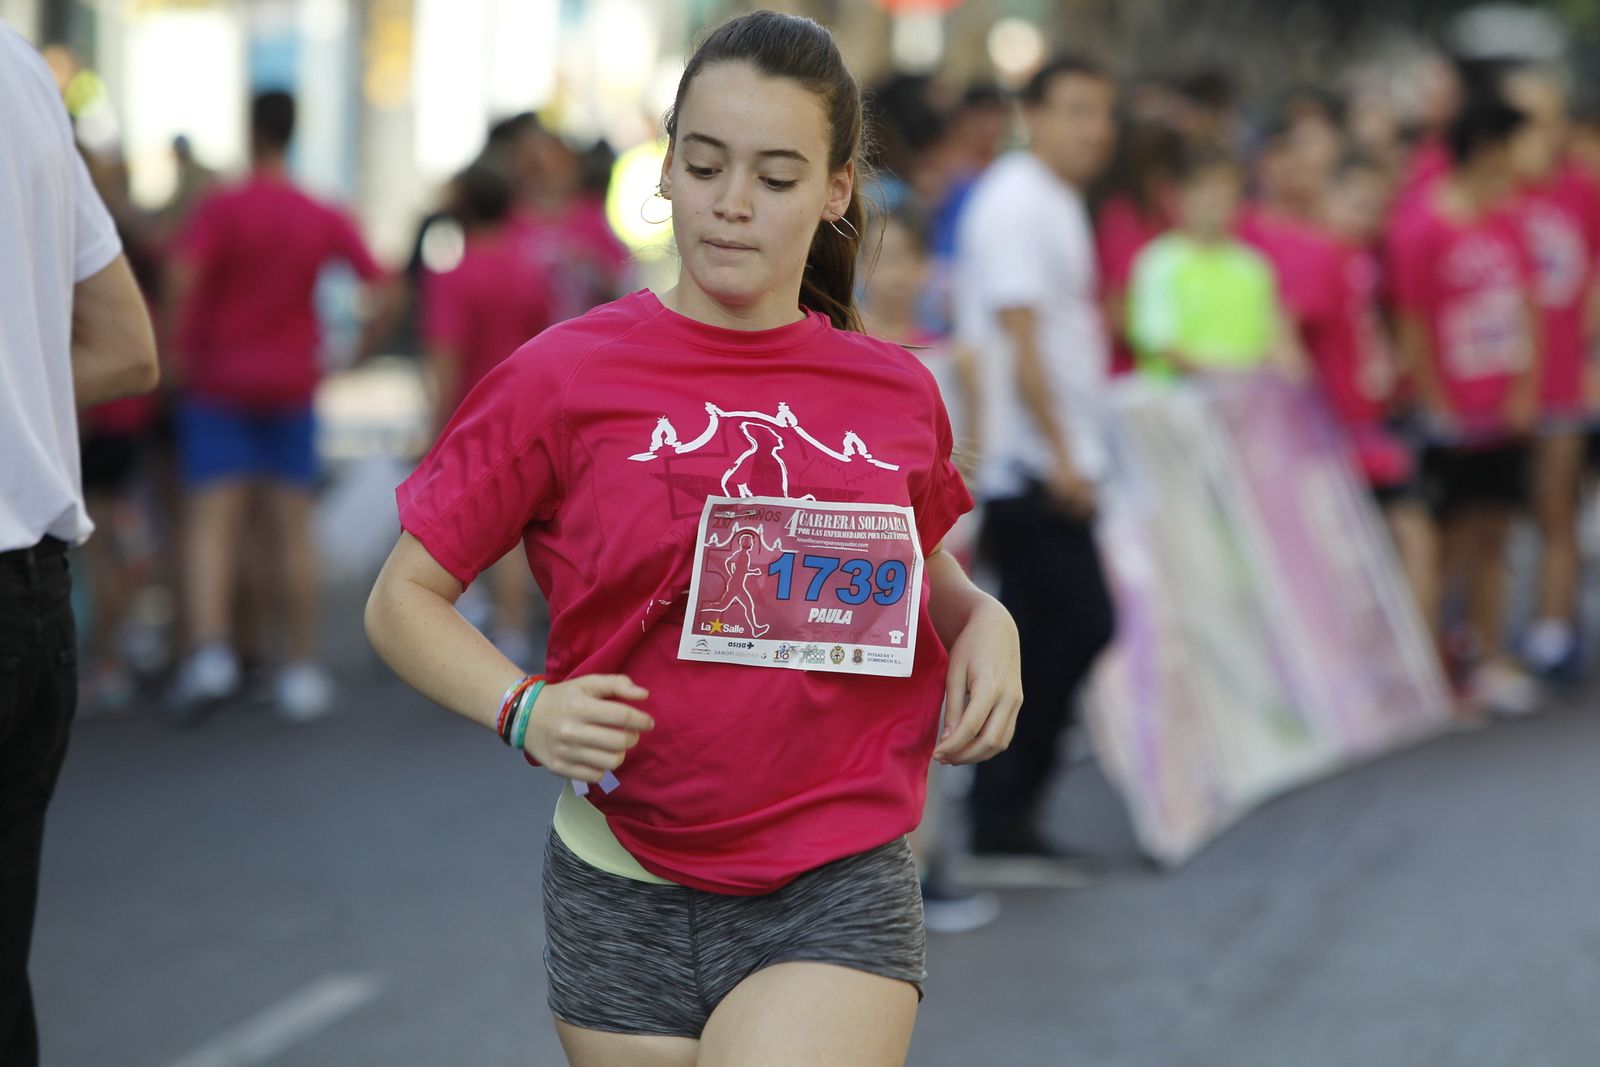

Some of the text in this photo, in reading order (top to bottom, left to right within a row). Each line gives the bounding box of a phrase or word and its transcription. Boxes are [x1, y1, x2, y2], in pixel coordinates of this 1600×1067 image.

[800, 512, 855, 530] CARRERA
[823, 530, 867, 540] ENFERMEDADES
[867, 532, 880, 540] POCO
[768, 552, 908, 606] 1739
[808, 608, 853, 625] PAULA
[700, 622, 744, 633] La Salle
[728, 641, 747, 649] asisa
